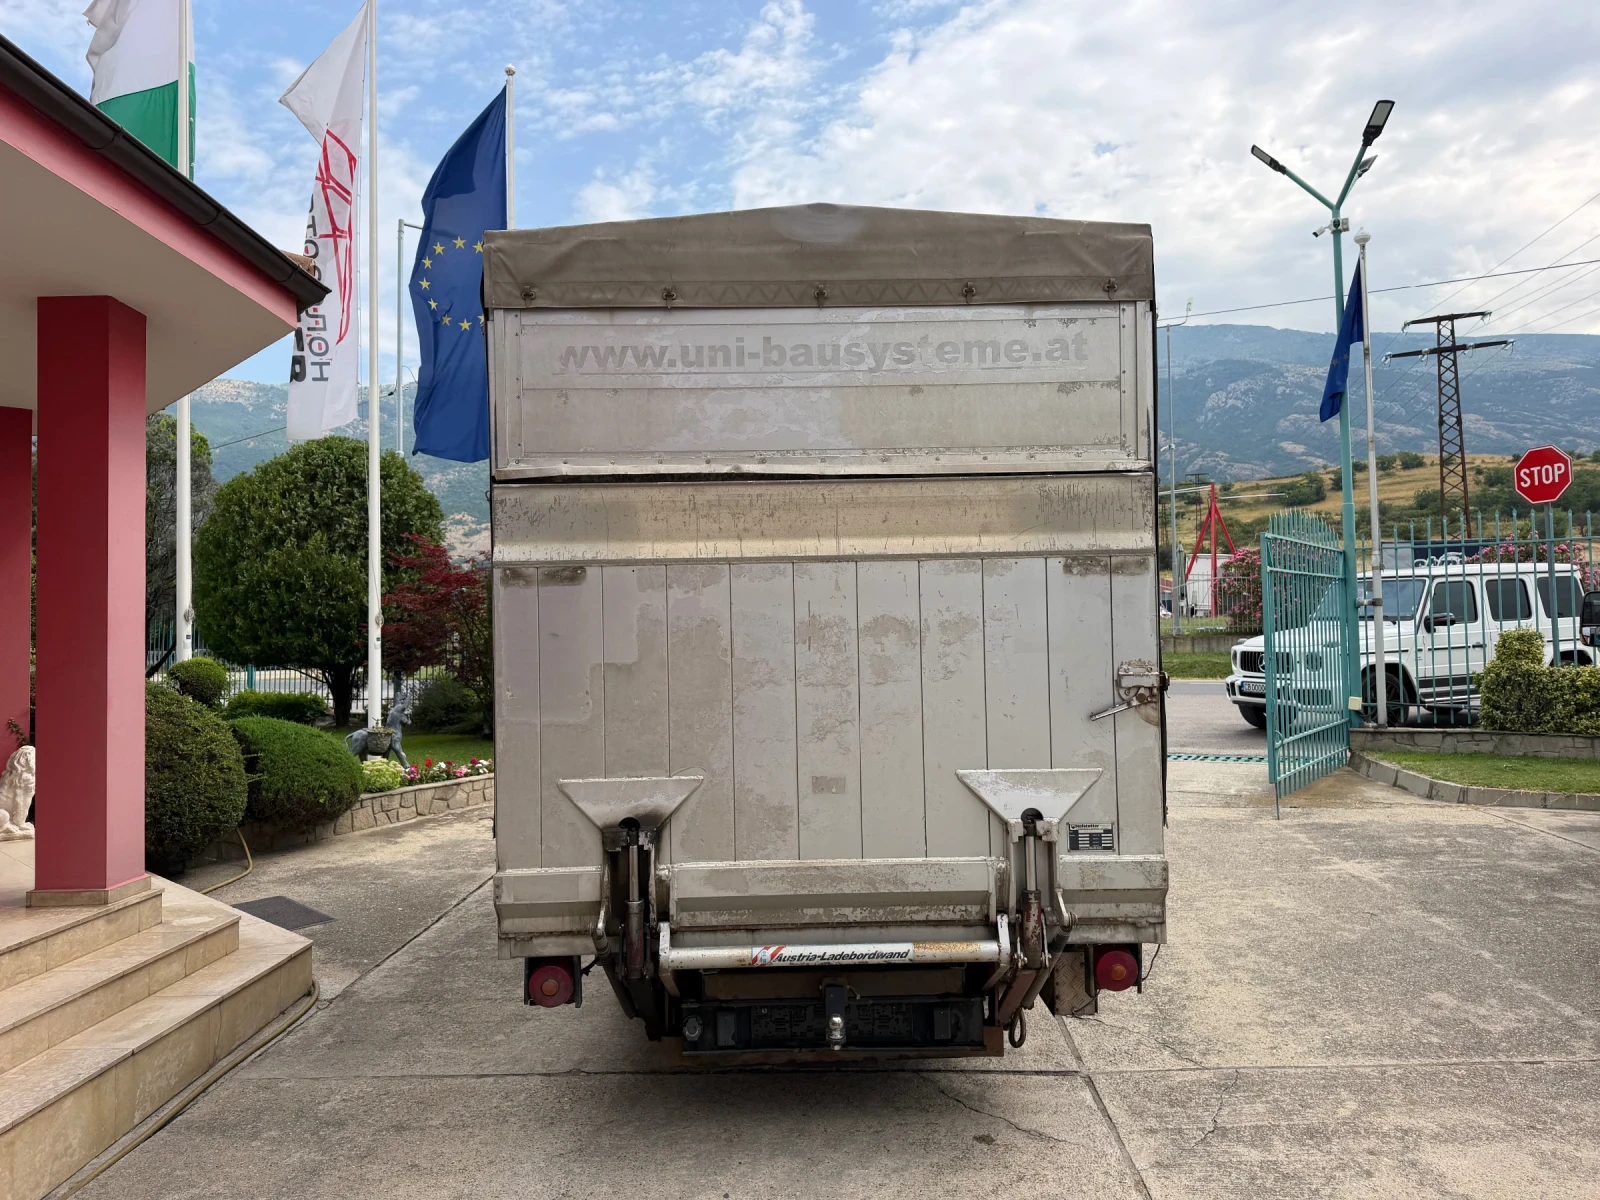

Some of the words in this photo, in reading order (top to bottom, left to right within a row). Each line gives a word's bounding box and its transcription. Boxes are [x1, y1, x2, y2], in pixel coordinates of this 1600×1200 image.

[559, 331, 1088, 372] www.uni-bausysteme.at
[1519, 462, 1565, 488] STOP
[773, 949, 911, 963] Austria-Ladebordwand
